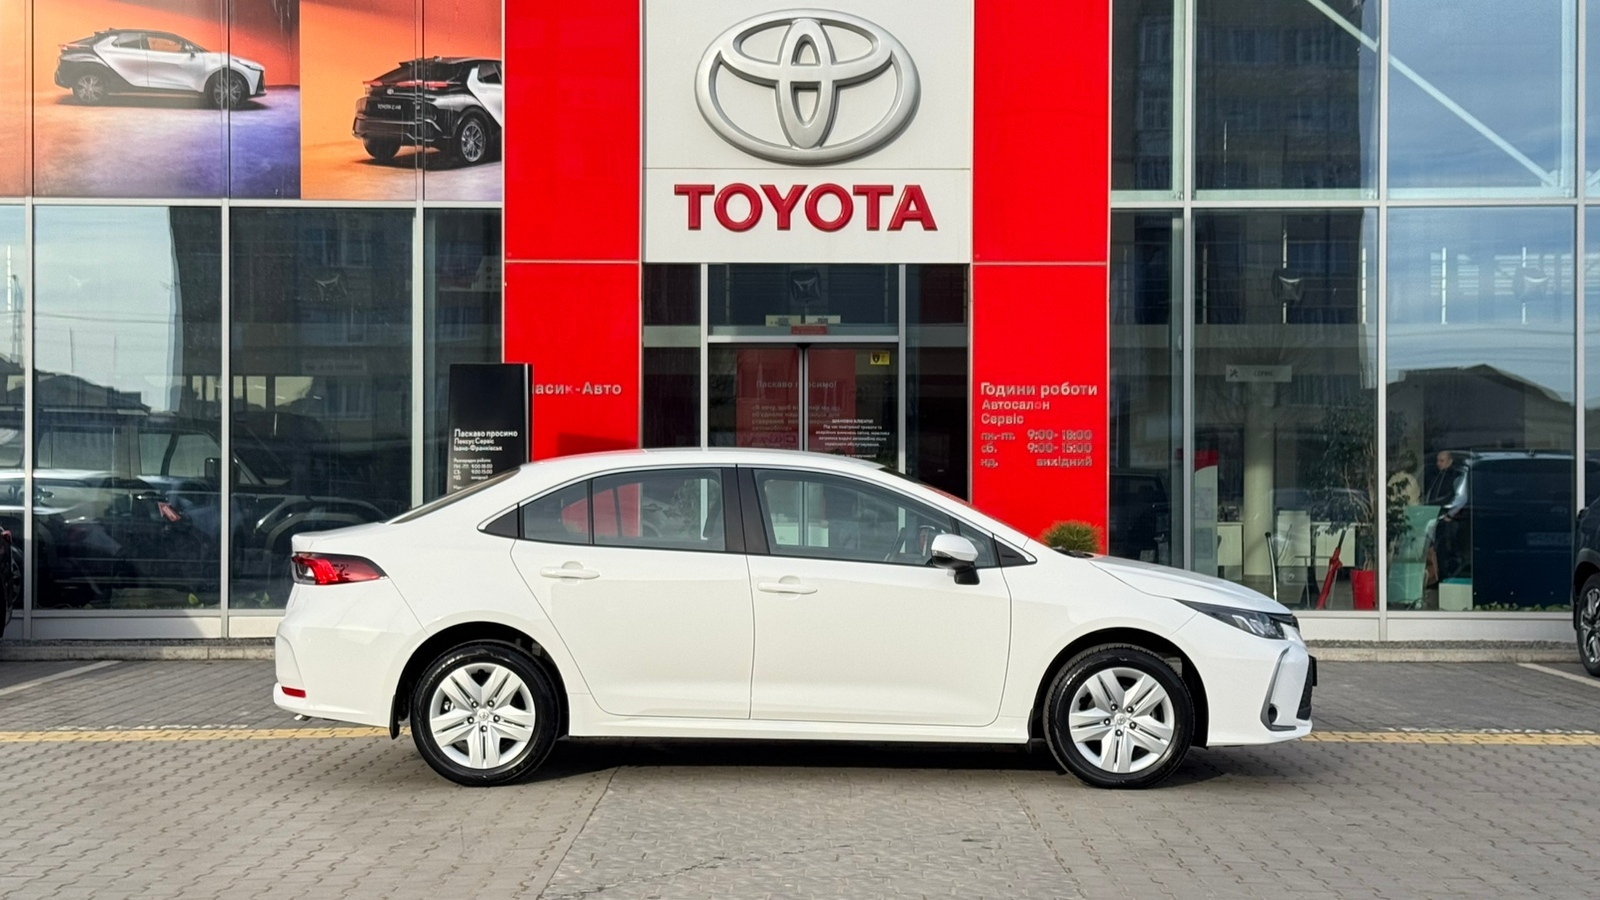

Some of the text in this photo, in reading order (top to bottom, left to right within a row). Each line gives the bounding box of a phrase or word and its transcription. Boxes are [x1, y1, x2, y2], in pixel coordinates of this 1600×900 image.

[674, 183, 938, 232] TOYOTA
[980, 382, 1098, 398] Години роботи
[982, 399, 1050, 410] Автосалон
[981, 413, 1024, 426] Сервіс
[486, 430, 518, 438] просимо
[475, 437, 495, 445] Сервіс
[981, 443, 997, 453] сб.
[1036, 456, 1092, 468] вихідний
